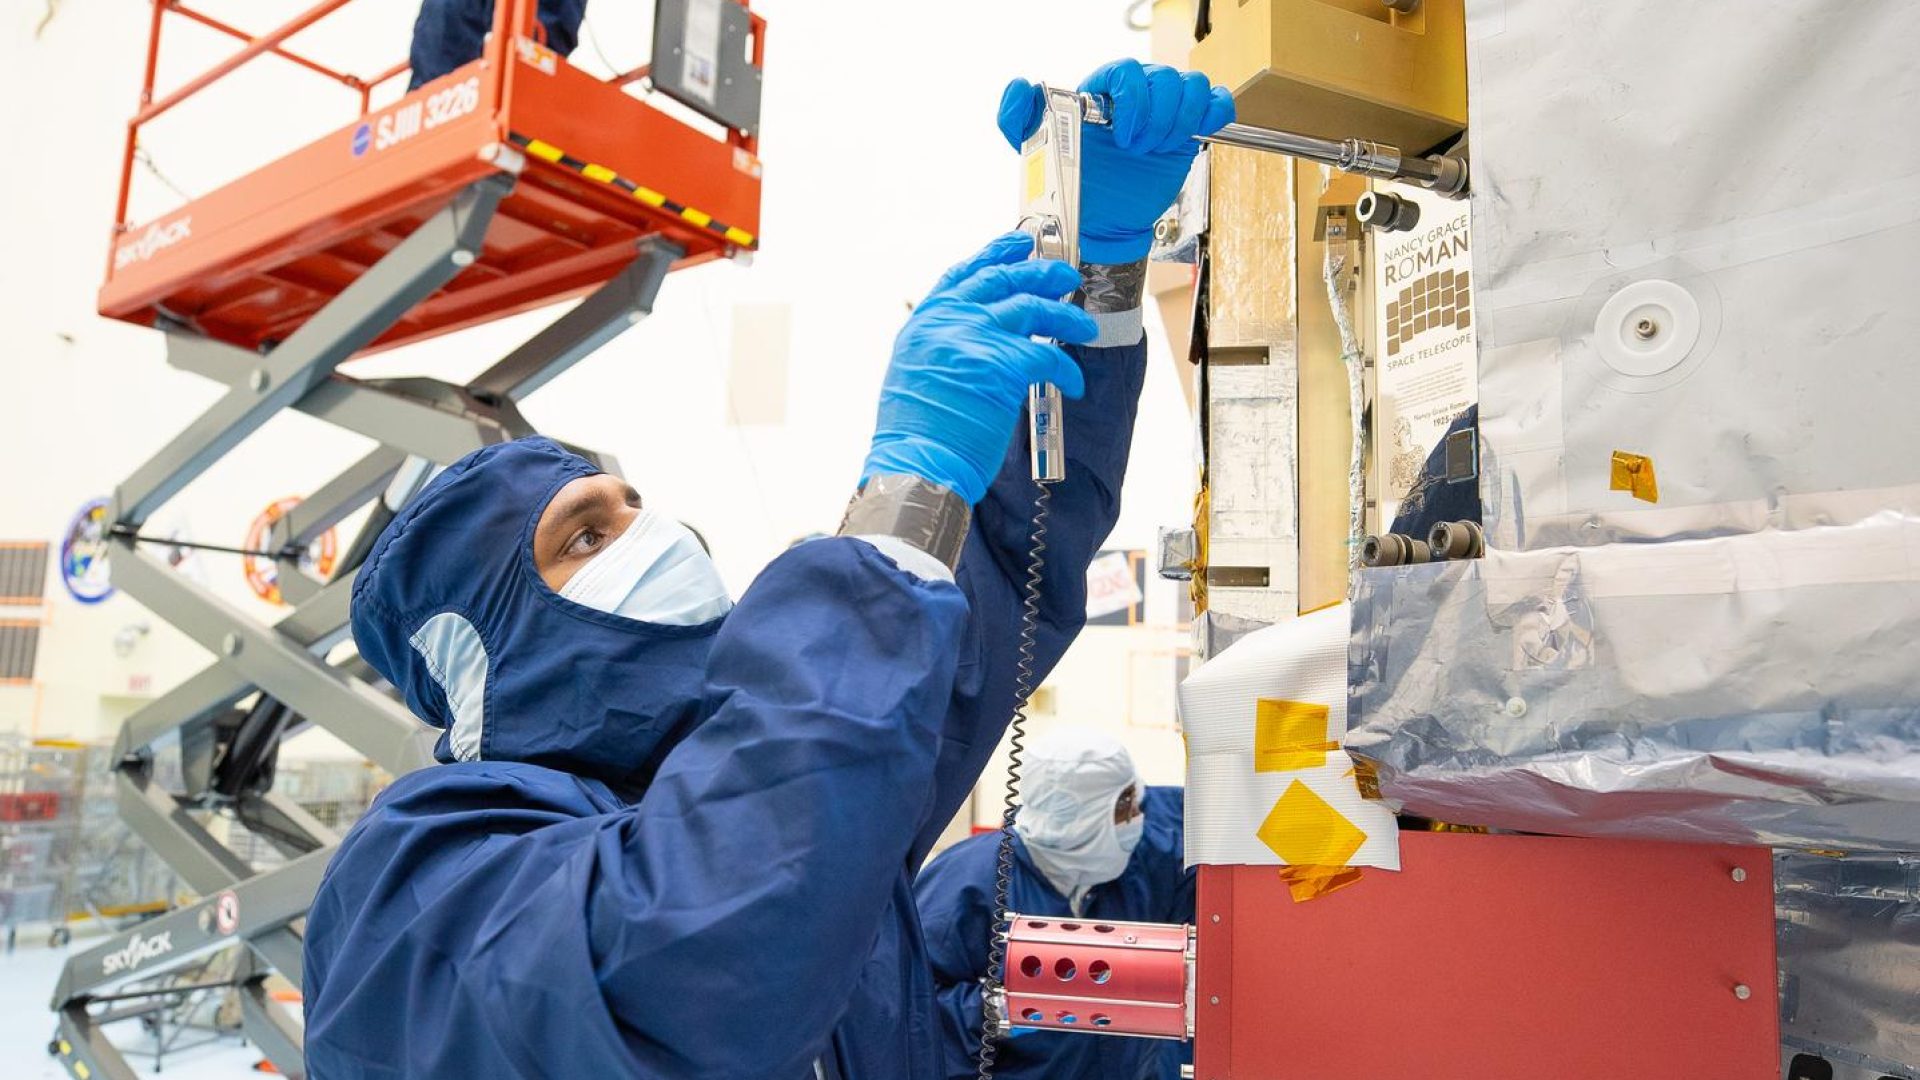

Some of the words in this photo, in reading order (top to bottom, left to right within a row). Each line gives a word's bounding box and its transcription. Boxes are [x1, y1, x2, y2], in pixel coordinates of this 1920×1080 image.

[425, 76, 479, 129] 3226
[1385, 234, 1424, 263] NANCY
[1427, 214, 1467, 242] GRACE
[1385, 231, 1468, 287] ROMAN
[1387, 354, 1414, 371] SPACE
[1418, 333, 1471, 359] TELESCOPE
[103, 931, 172, 975] SKYJACK
